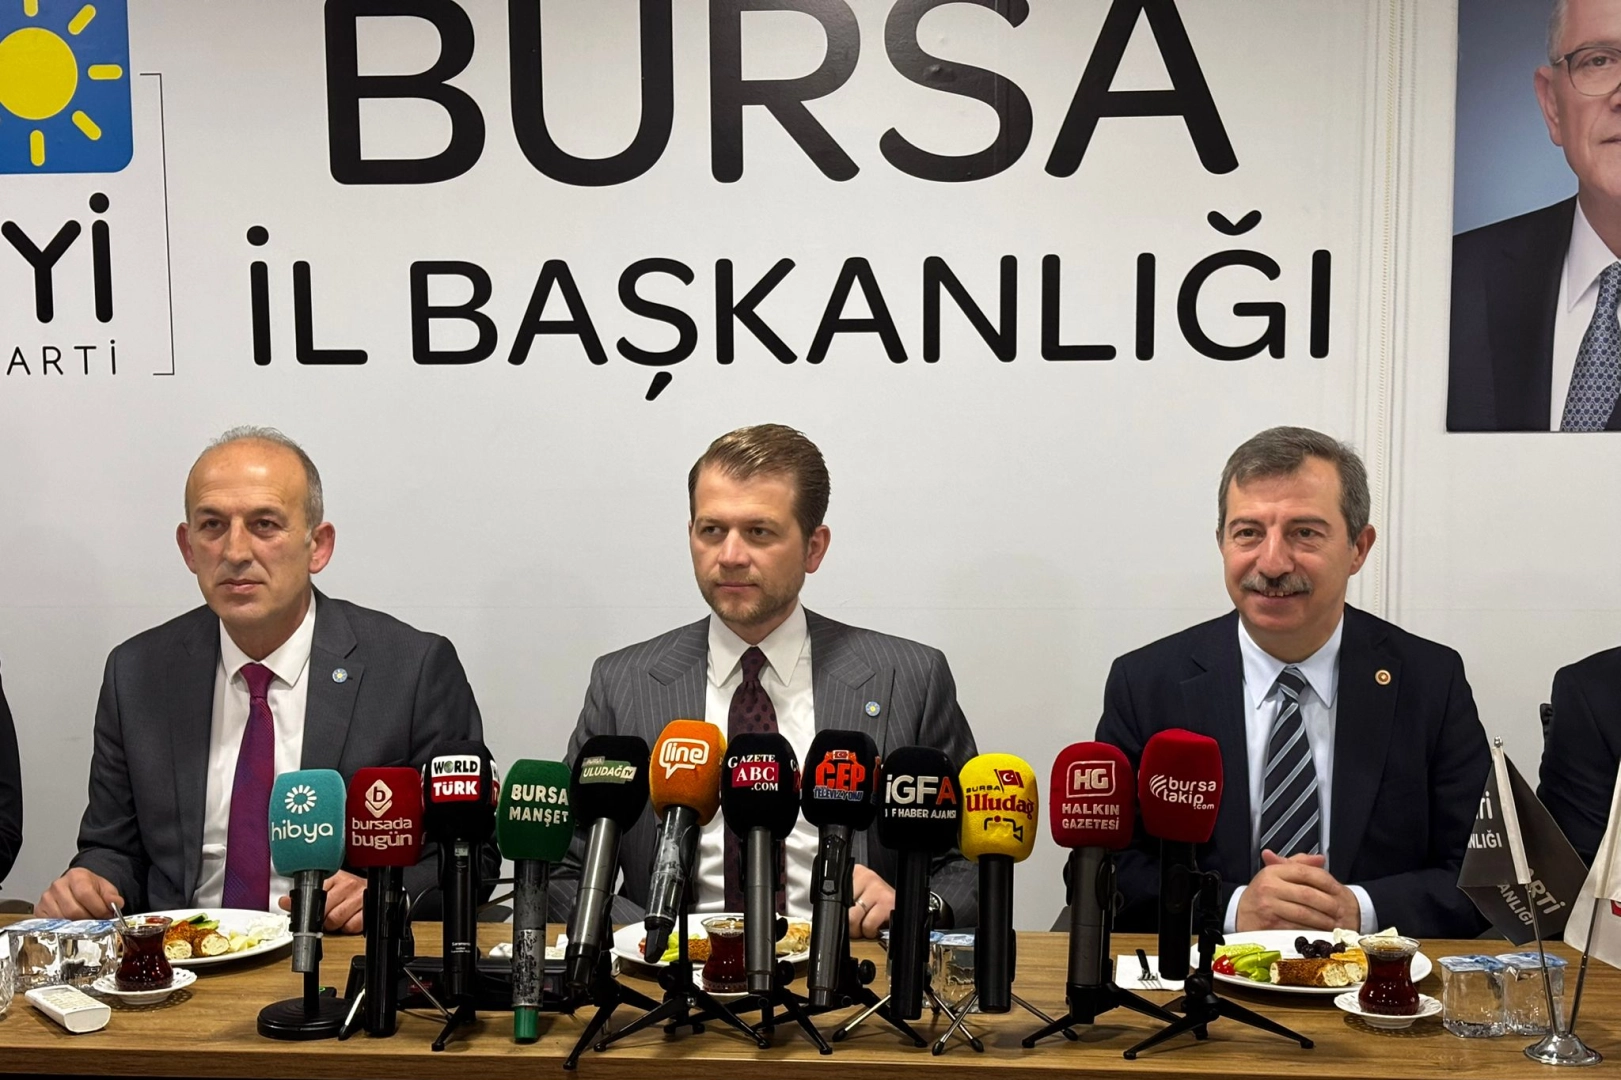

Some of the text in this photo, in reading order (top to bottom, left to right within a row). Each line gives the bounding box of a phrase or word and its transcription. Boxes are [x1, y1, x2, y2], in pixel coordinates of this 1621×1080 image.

[325, 0, 1238, 186] BURSA
[247, 209, 1332, 401] İL BAŞKANLIĞI
[663, 742, 706, 764] line
[433, 760, 478, 774] WORLD
[728, 754, 776, 769] GAZETE
[583, 765, 623, 778] ULUDAĞ
[736, 766, 775, 782] ABC
[815, 762, 866, 792] CEP
[1073, 768, 1109, 790] HG
[433, 780, 478, 797] TÜRK
[751, 782, 779, 791] .COM
[966, 785, 1000, 793] BURSA
[1168, 777, 1217, 792] bursa
[511, 784, 569, 806] BURSA
[1163, 788, 1204, 807] takip
[509, 806, 569, 827] MANŞET
[898, 808, 929, 819] HABER
[930, 809, 957, 819] AJANSI
[1062, 803, 1120, 815] HALKIN
[271, 819, 334, 843] hibya
[352, 817, 412, 830] bursada
[1062, 817, 1120, 830] GAZETESİ
[352, 831, 412, 850] bugün
